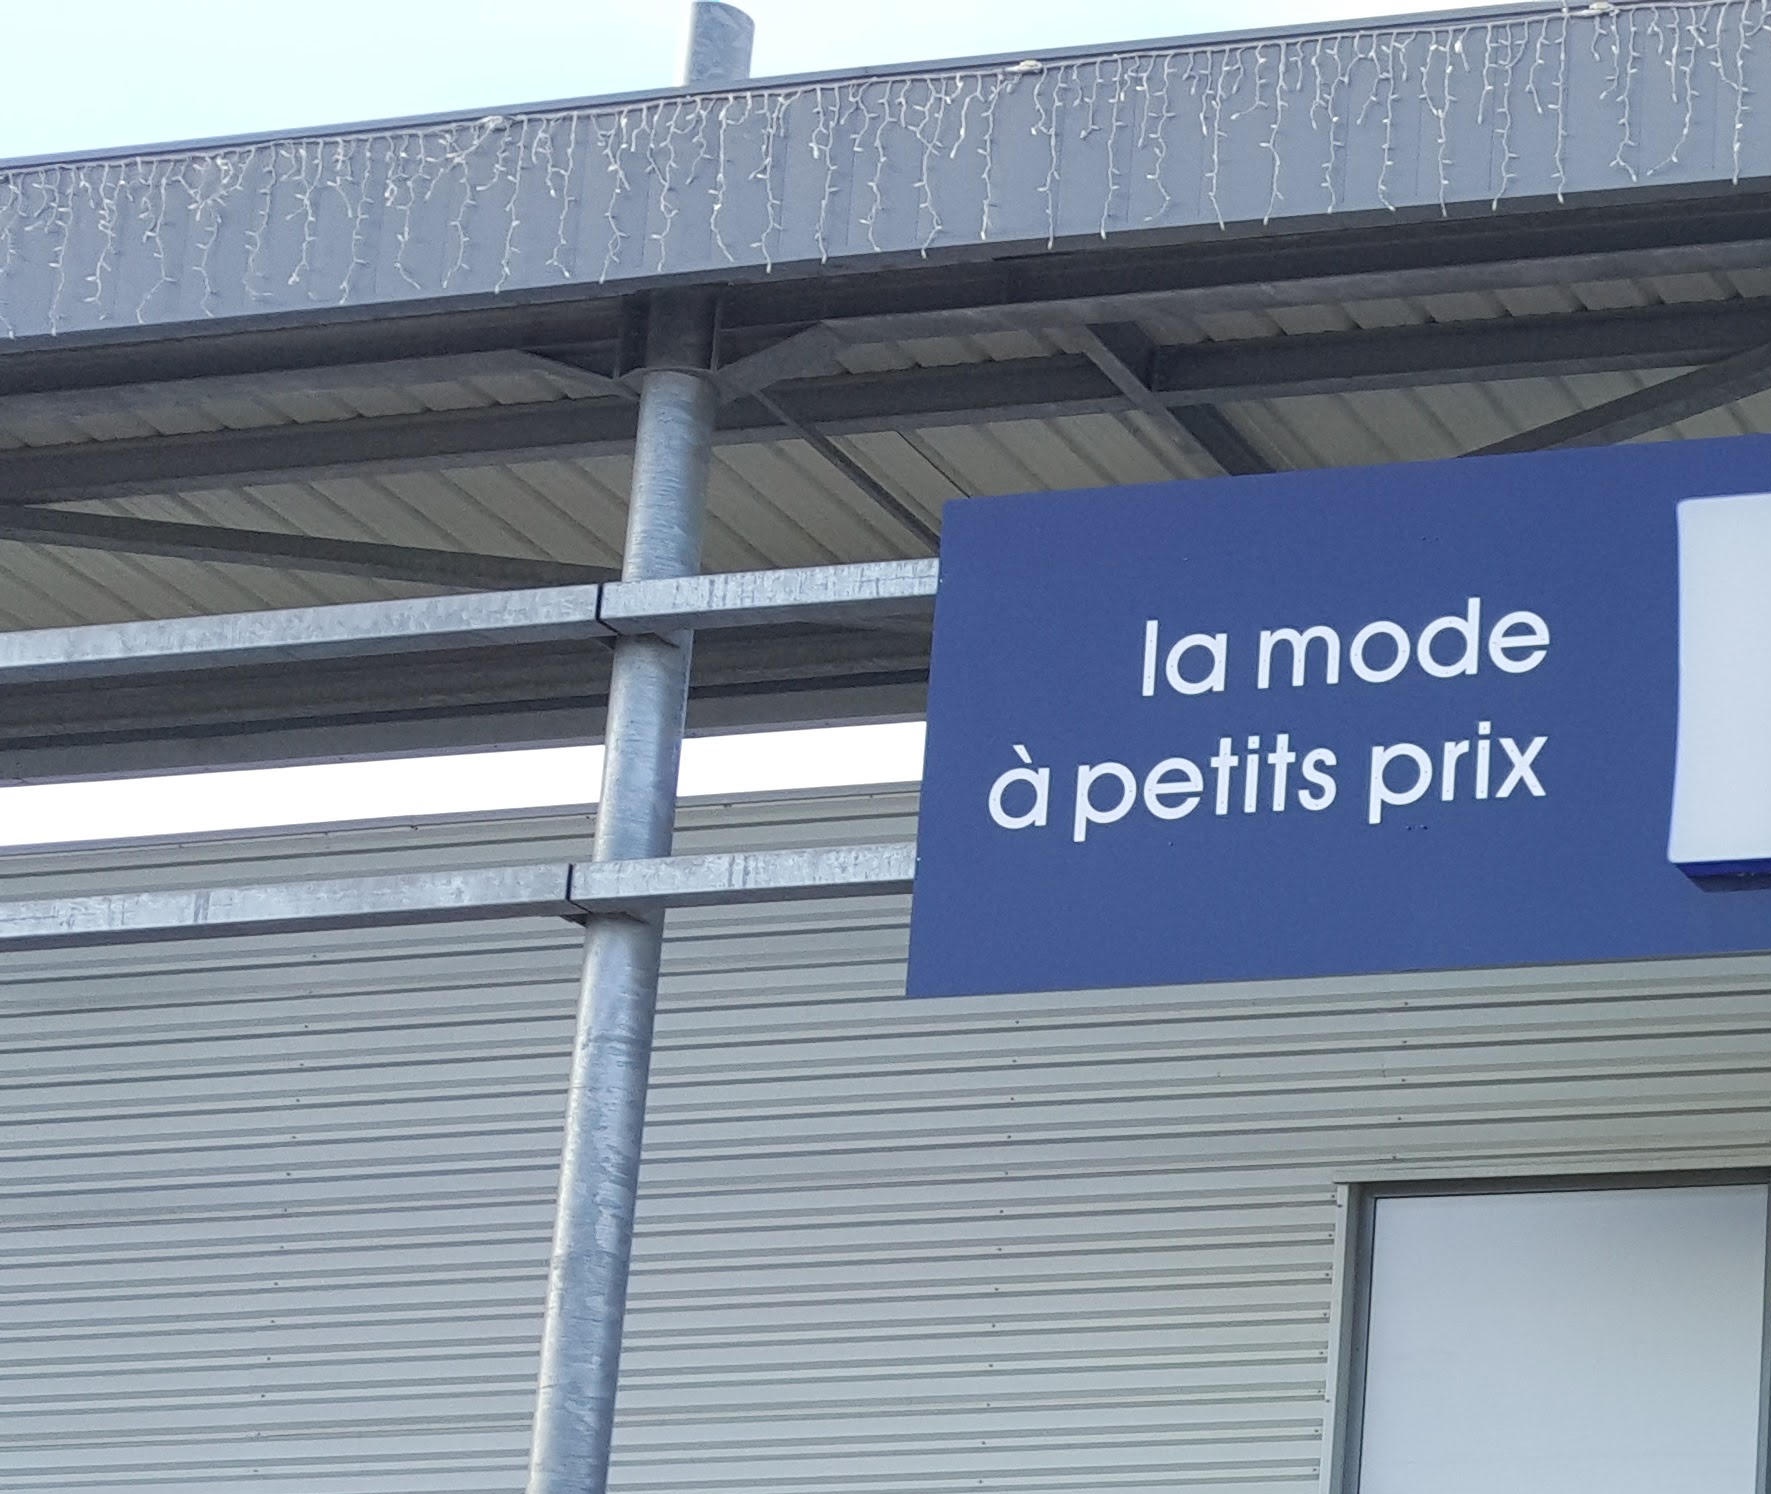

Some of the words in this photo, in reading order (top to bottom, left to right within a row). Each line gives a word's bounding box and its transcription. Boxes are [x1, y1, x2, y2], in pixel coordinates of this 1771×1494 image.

[1142, 619, 1228, 697] la
[1257, 597, 1551, 690] mode
[988, 744, 1051, 829] à
[1073, 733, 1338, 843] petits
[1368, 720, 1549, 824] prix
